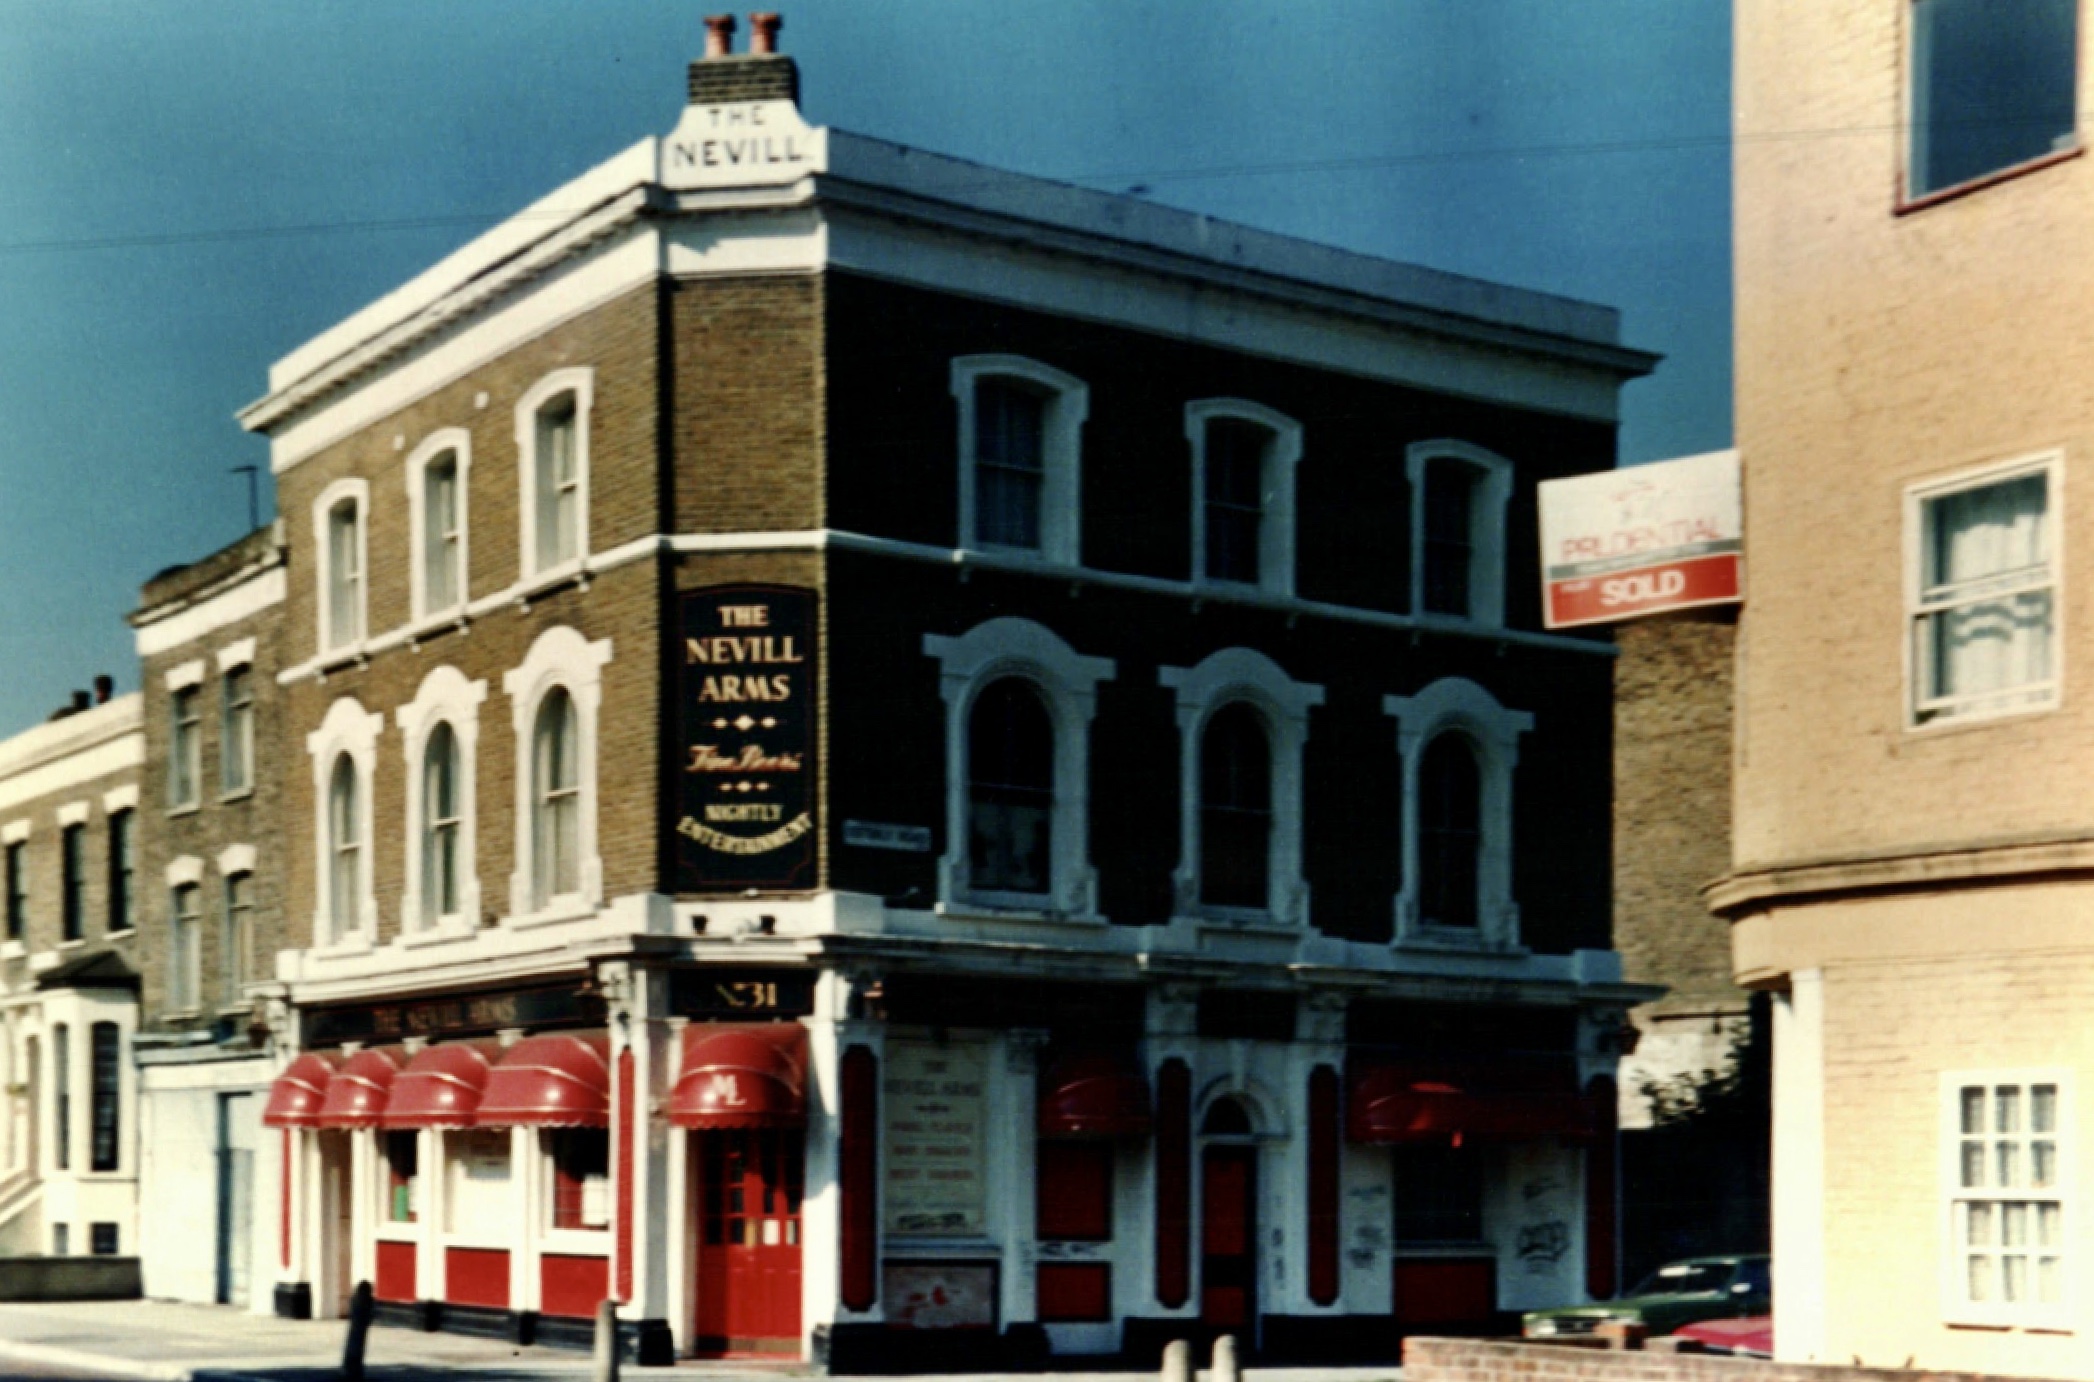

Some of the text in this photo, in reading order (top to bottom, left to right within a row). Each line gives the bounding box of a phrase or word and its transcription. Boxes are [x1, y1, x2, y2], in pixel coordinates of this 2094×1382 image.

[708, 105, 767, 127] THE
[674, 137, 804, 167] NEVILL
[1600, 569, 1686, 607] SOLD
[718, 604, 769, 627] THE
[686, 636, 803, 664] NEVILL
[699, 674, 792, 702] ARMS
[704, 803, 784, 821] NIGHTLY
[676, 812, 812, 855] ENTERTAINMENT
